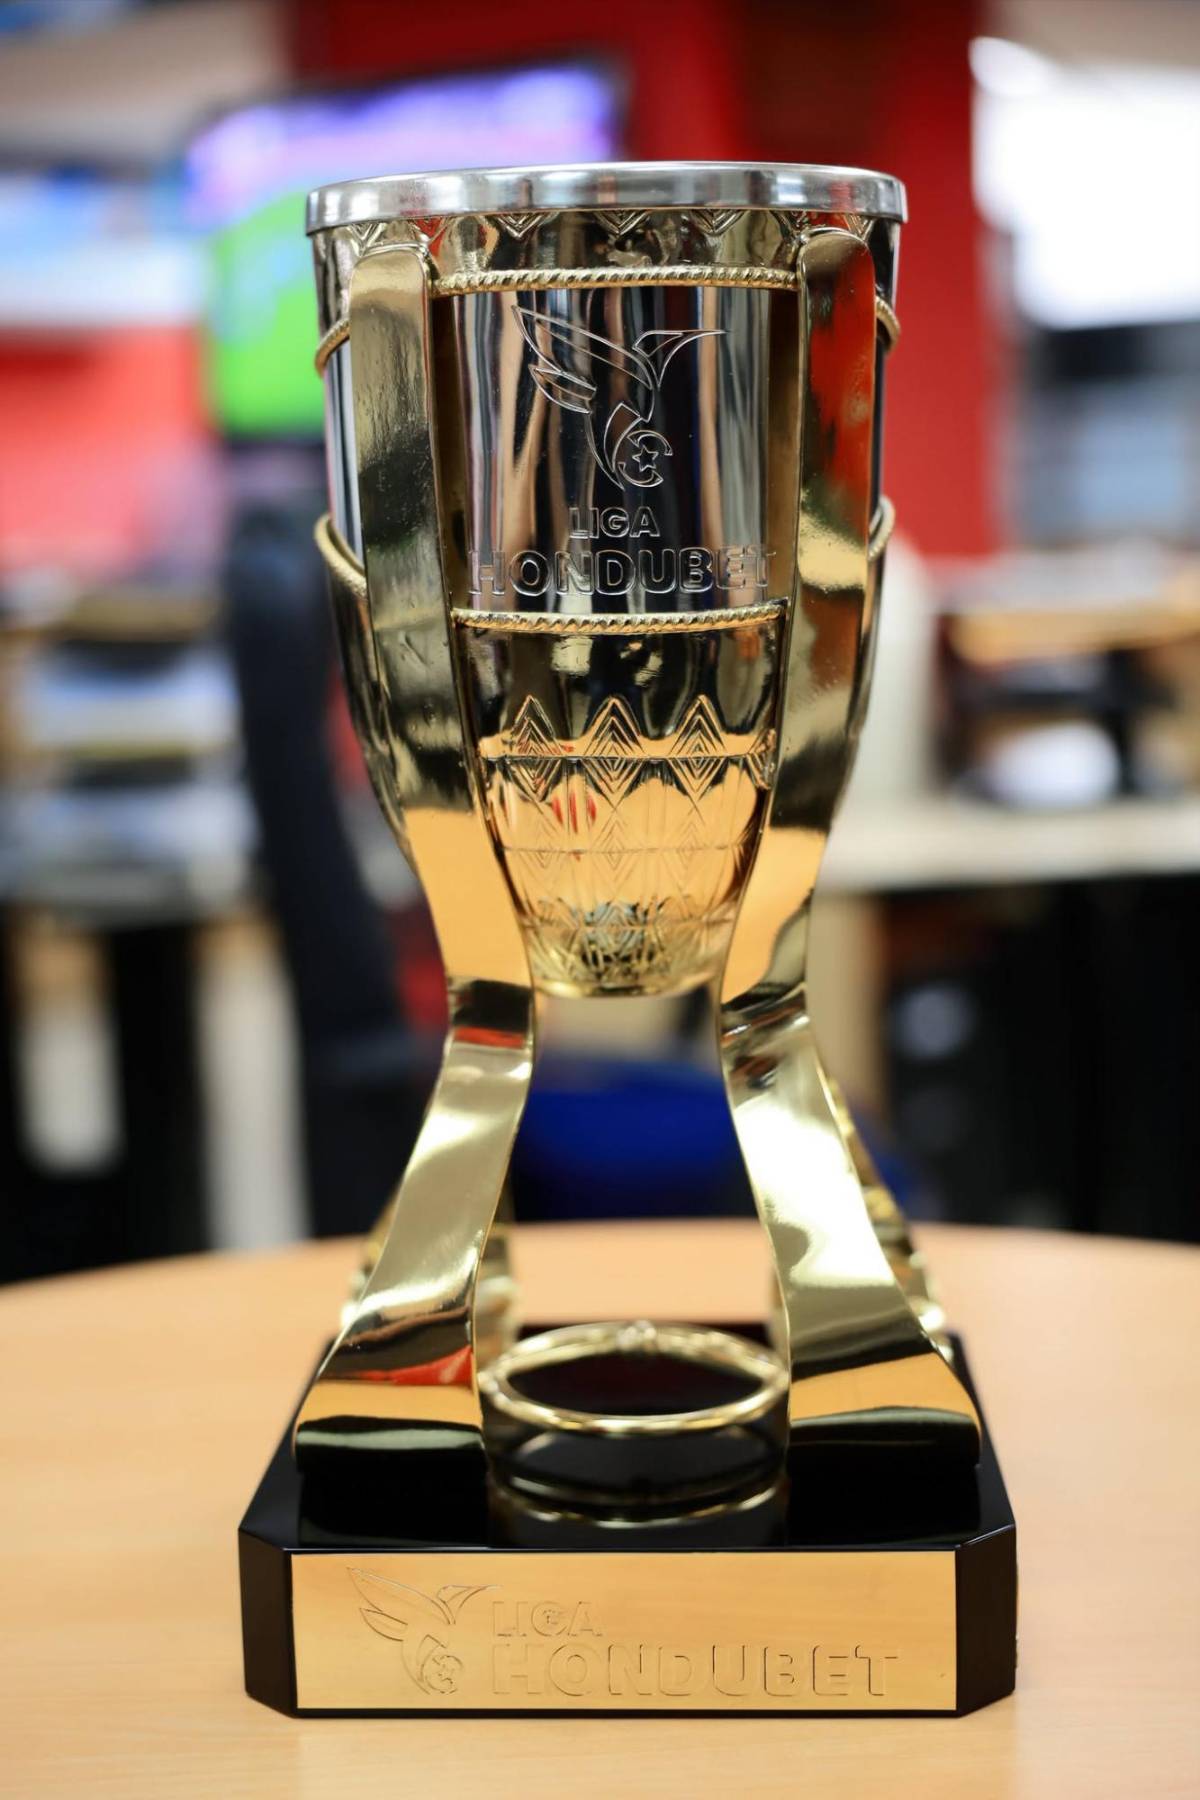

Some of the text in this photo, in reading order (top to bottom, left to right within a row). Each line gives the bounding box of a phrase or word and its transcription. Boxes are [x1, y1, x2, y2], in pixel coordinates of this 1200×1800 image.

[569, 507, 660, 539] LIGA
[469, 544, 777, 596] HONDUBET
[492, 1601, 603, 1637] LIGA
[492, 1643, 898, 1696] HONDUBET
